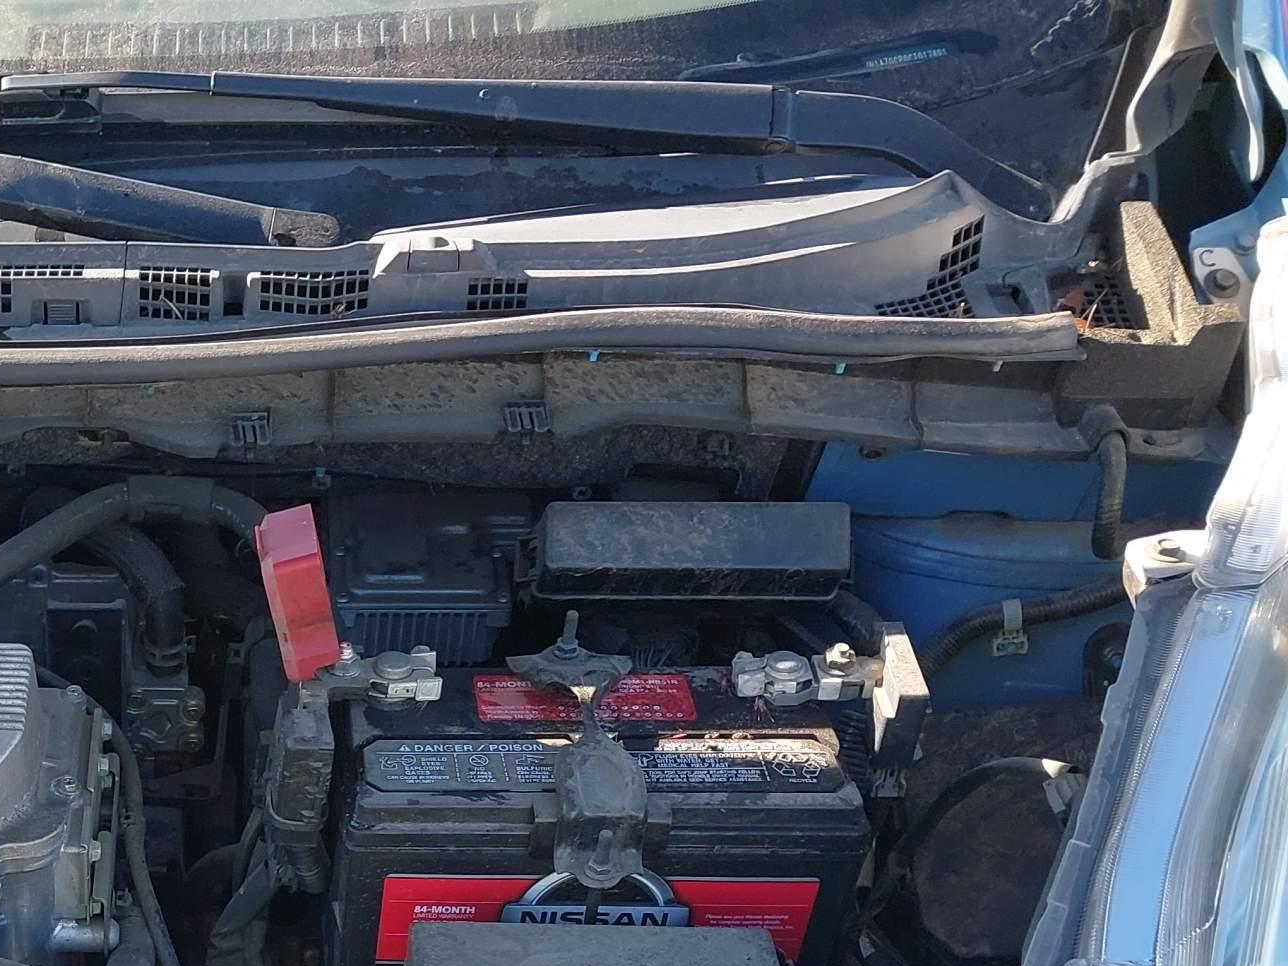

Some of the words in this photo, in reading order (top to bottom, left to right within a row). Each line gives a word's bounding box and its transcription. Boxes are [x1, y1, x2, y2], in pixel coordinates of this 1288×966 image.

[414, 744, 473, 752] DANGER
[489, 743, 543, 752] POISON
[414, 905, 475, 914] 84-MONTH
